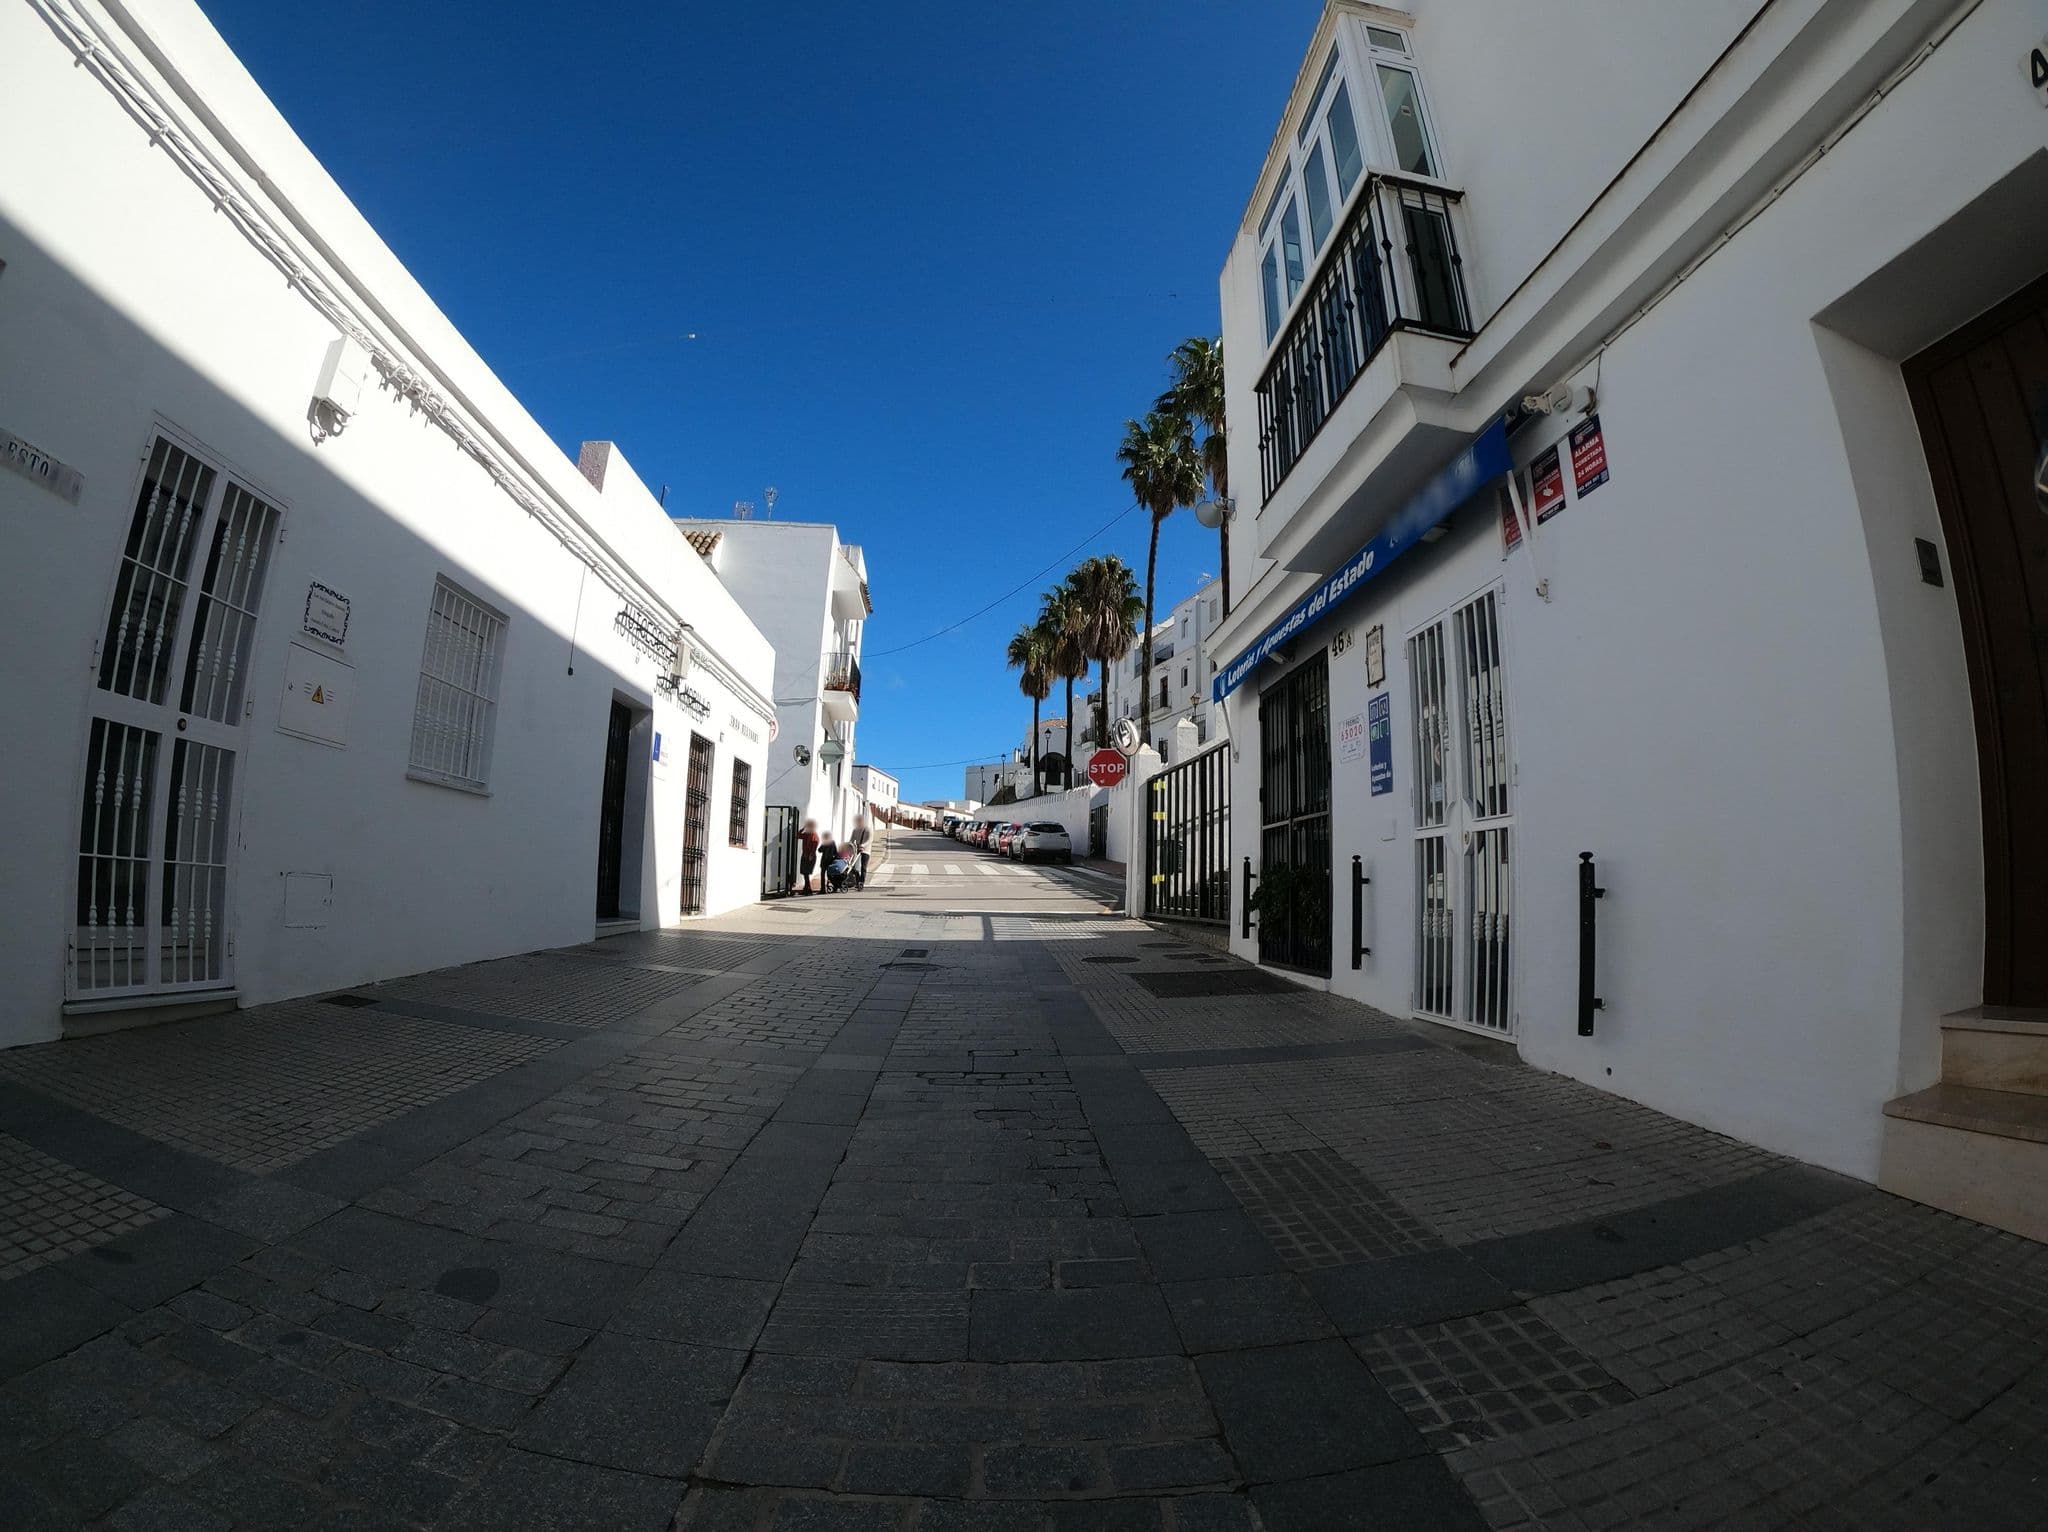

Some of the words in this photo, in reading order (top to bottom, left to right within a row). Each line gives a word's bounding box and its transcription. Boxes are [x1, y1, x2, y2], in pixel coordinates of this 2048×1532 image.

[1574, 436, 1600, 457] ALARMA
[1585, 457, 1603, 474] HORAS
[1262, 607, 1306, 656] Apuestas
[1308, 587, 1328, 618] del
[1329, 550, 1375, 602] Estado
[1332, 631, 1345, 657] 46
[1090, 763, 1125, 774] STOP
